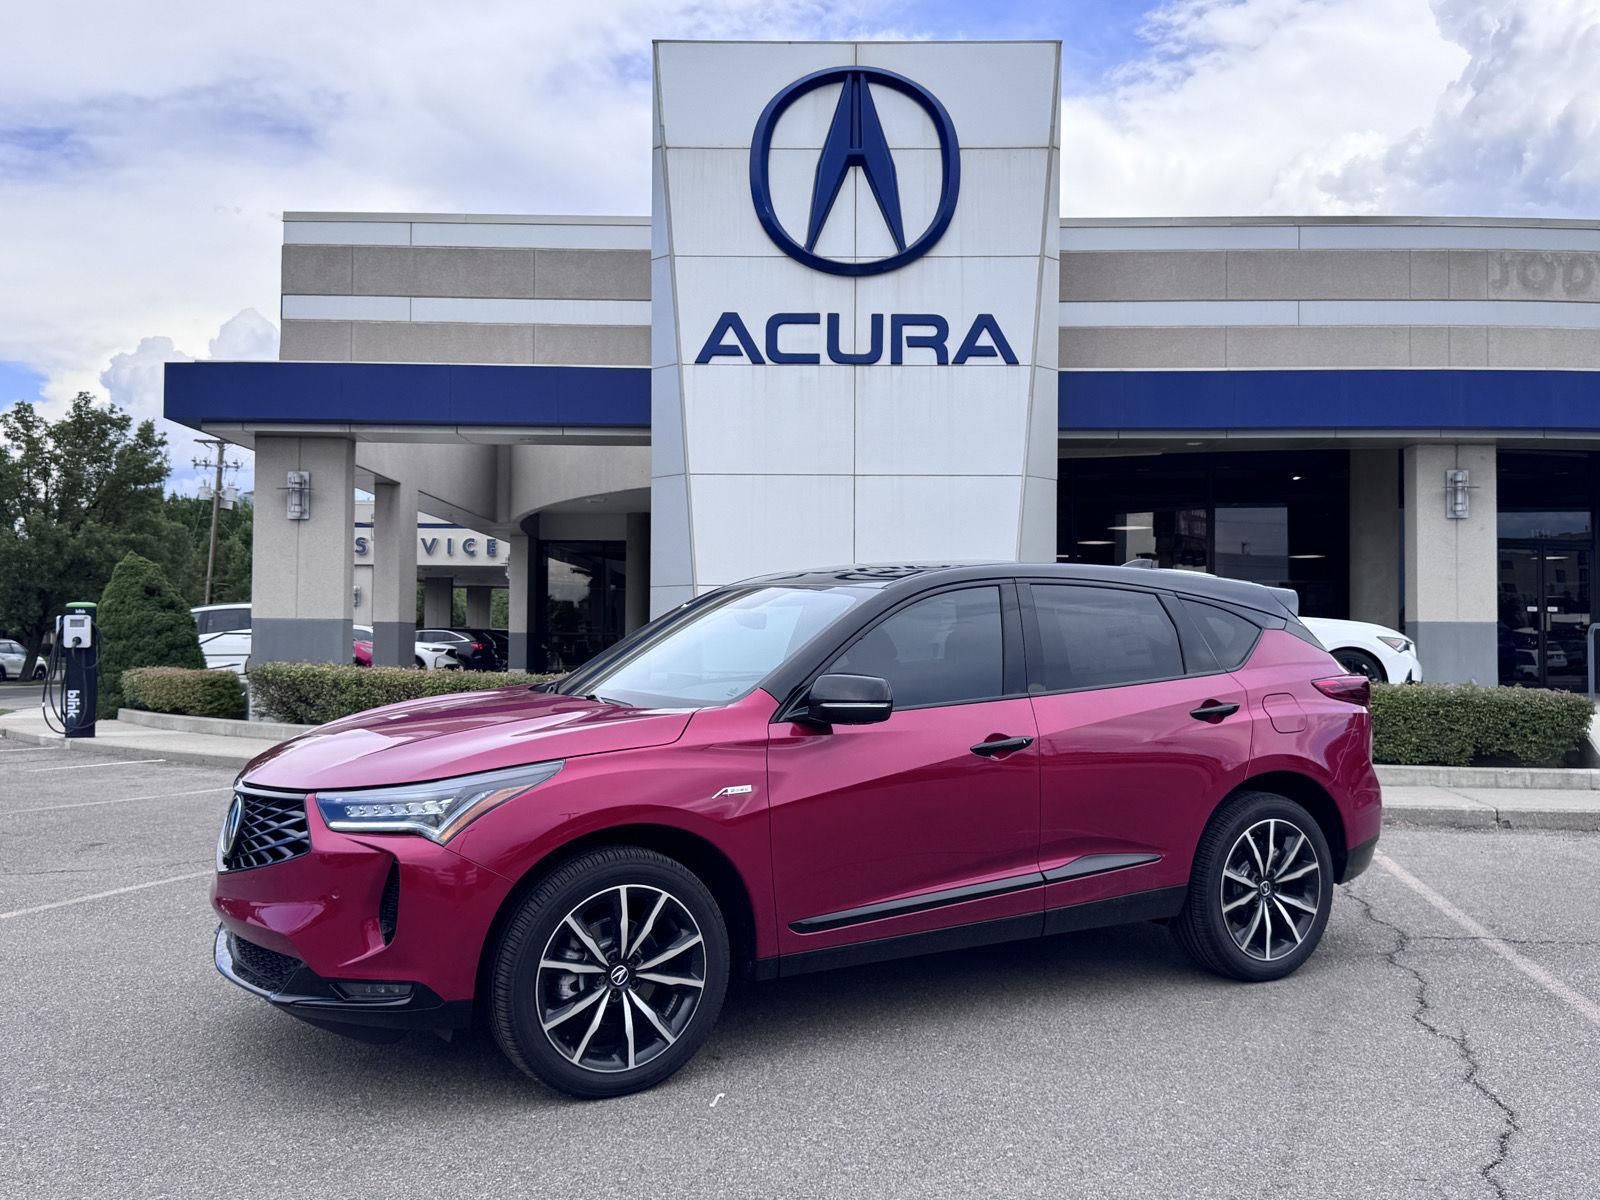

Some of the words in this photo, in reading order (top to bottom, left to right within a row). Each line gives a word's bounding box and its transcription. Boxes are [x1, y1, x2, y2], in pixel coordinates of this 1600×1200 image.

[695, 311, 1020, 365] ACURA
[354, 536, 497, 557] SVICE
[67, 690, 80, 718] blink
